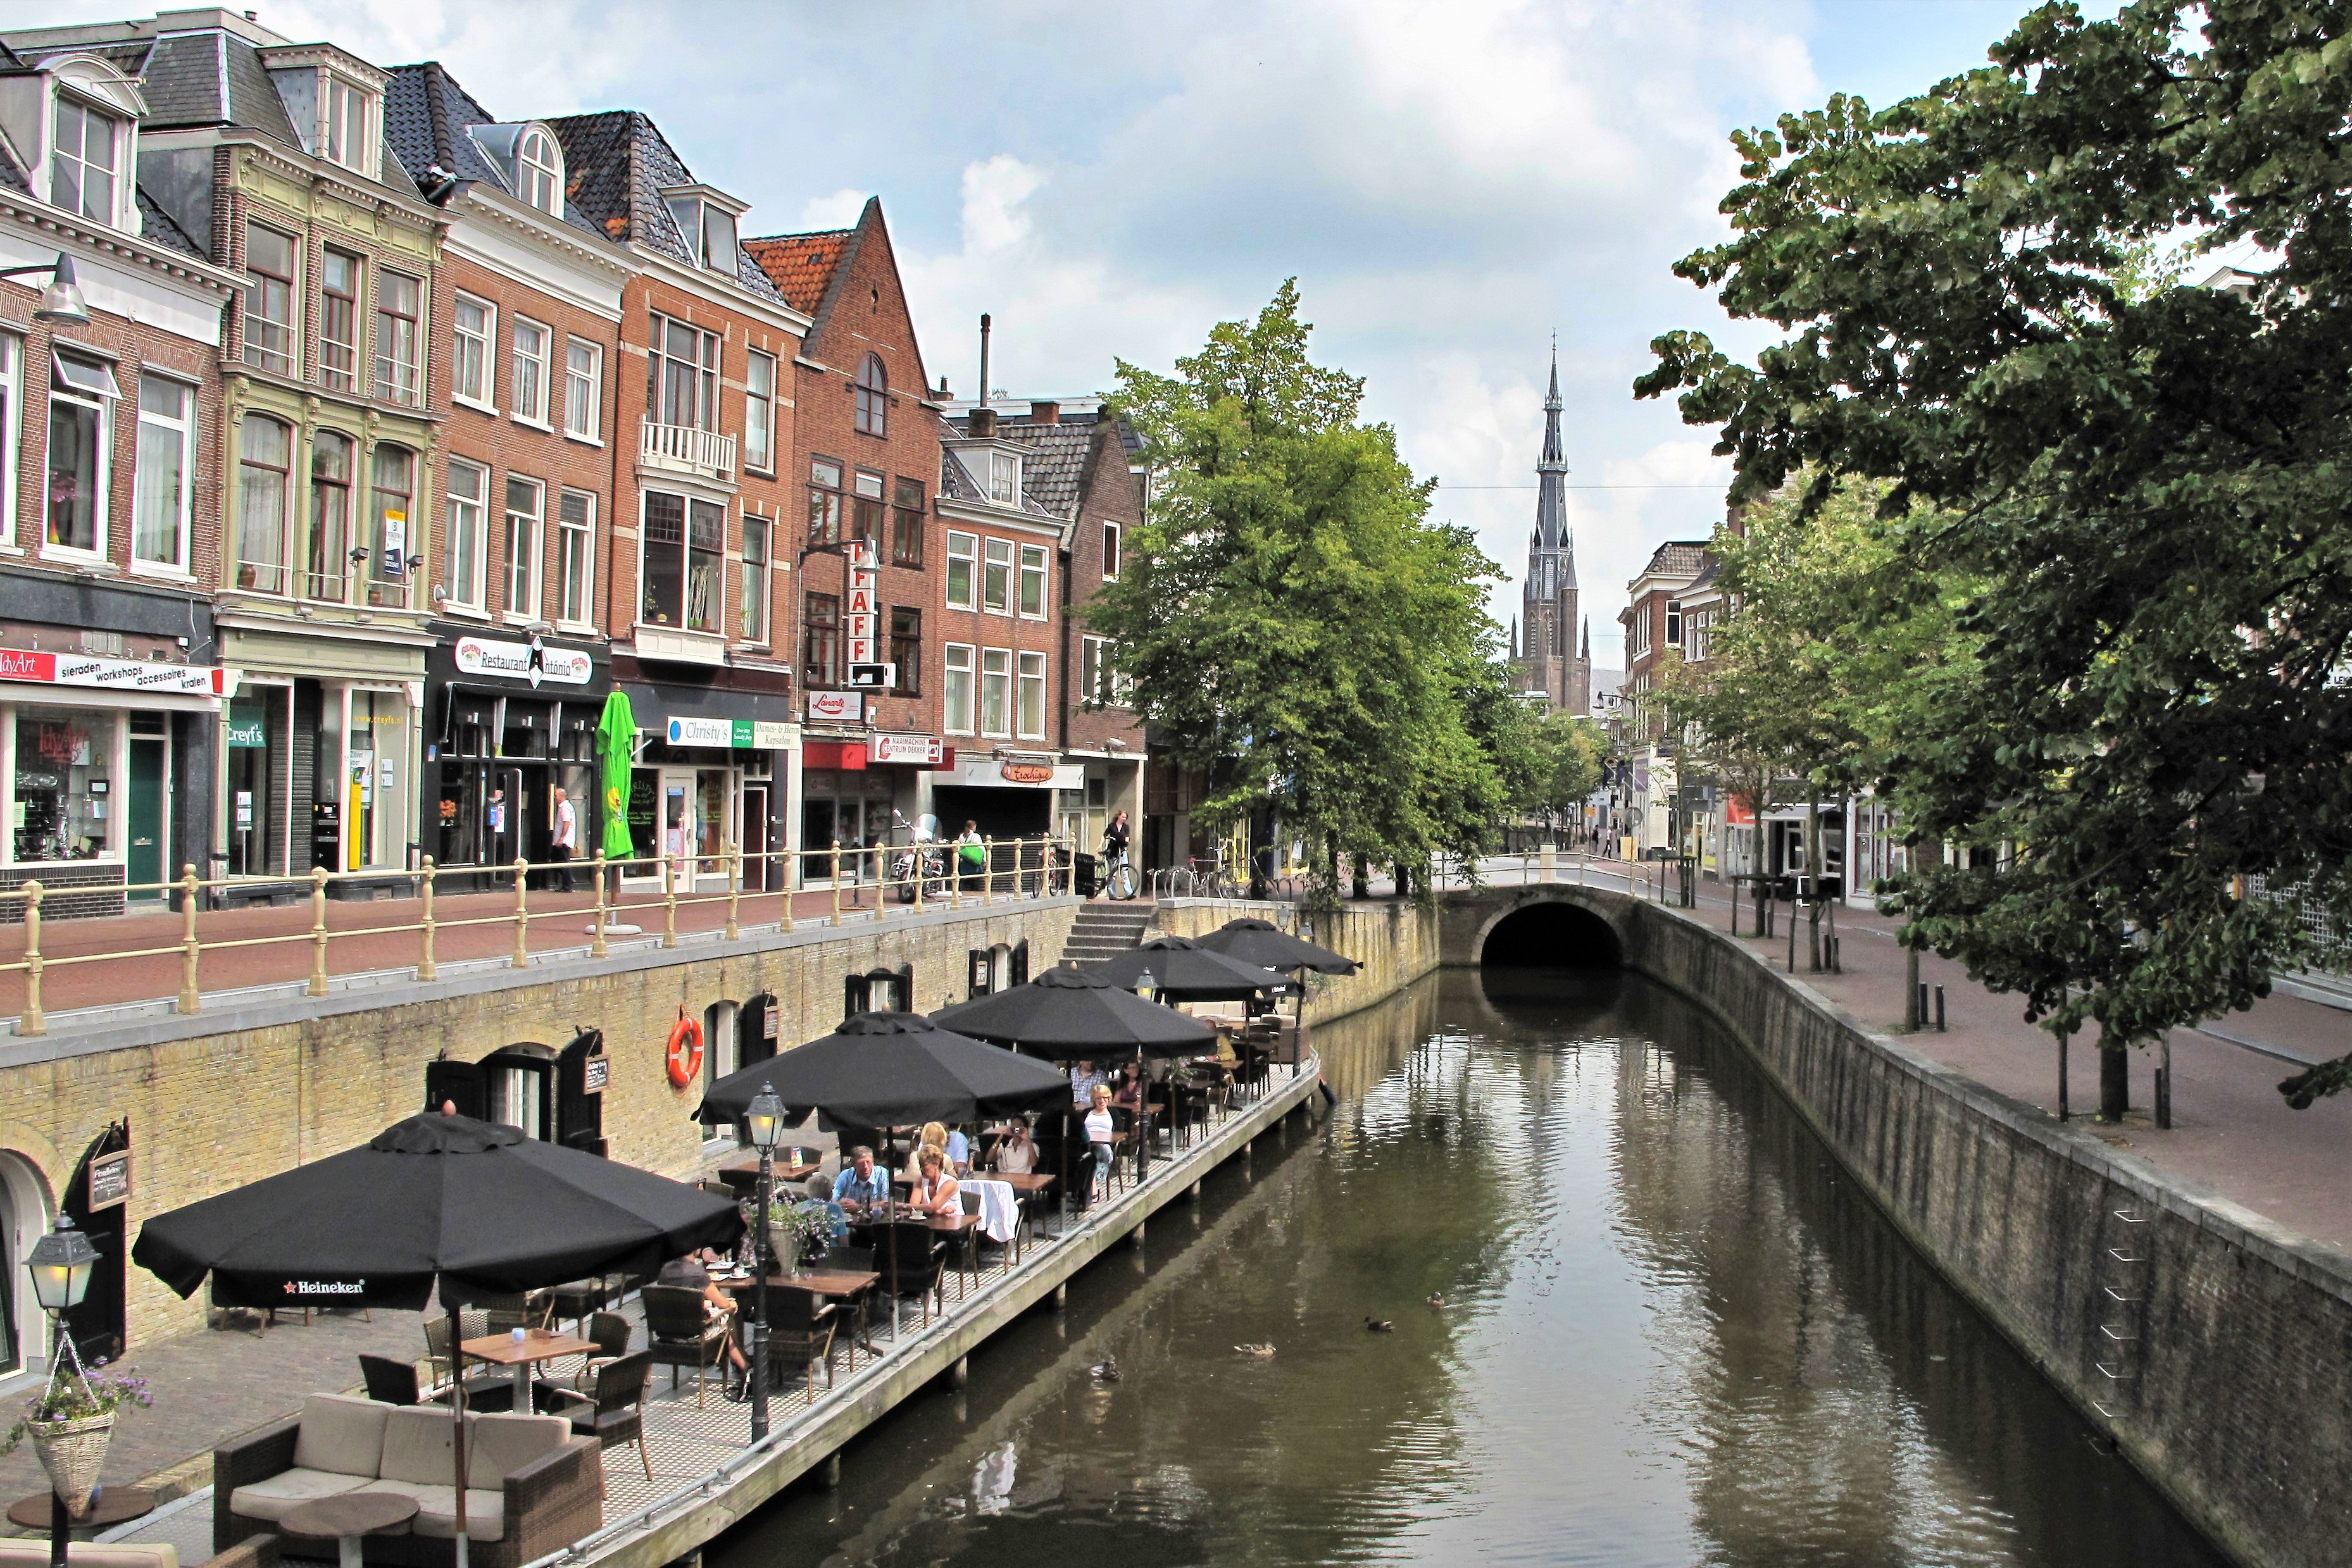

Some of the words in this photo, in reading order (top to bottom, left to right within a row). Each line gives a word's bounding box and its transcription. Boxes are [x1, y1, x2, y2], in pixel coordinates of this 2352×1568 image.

[482, 652, 527, 671] Restaurant
[61, 663, 101, 678] sieraden
[96, 666, 143, 683] workshops
[137, 669, 186, 685] accessoires
[181, 677, 206, 689] kralen
[756, 723, 777, 733] Dames-
[778, 724, 784, 733] &
[784, 724, 799, 734] Heren
[765, 735, 791, 747] Kapsalon
[892, 737, 926, 747] NAAIMACHINE
[884, 745, 906, 753] CENTRUM
[908, 745, 926, 754] DEKKER
[297, 1281, 364, 1293] Heineken
